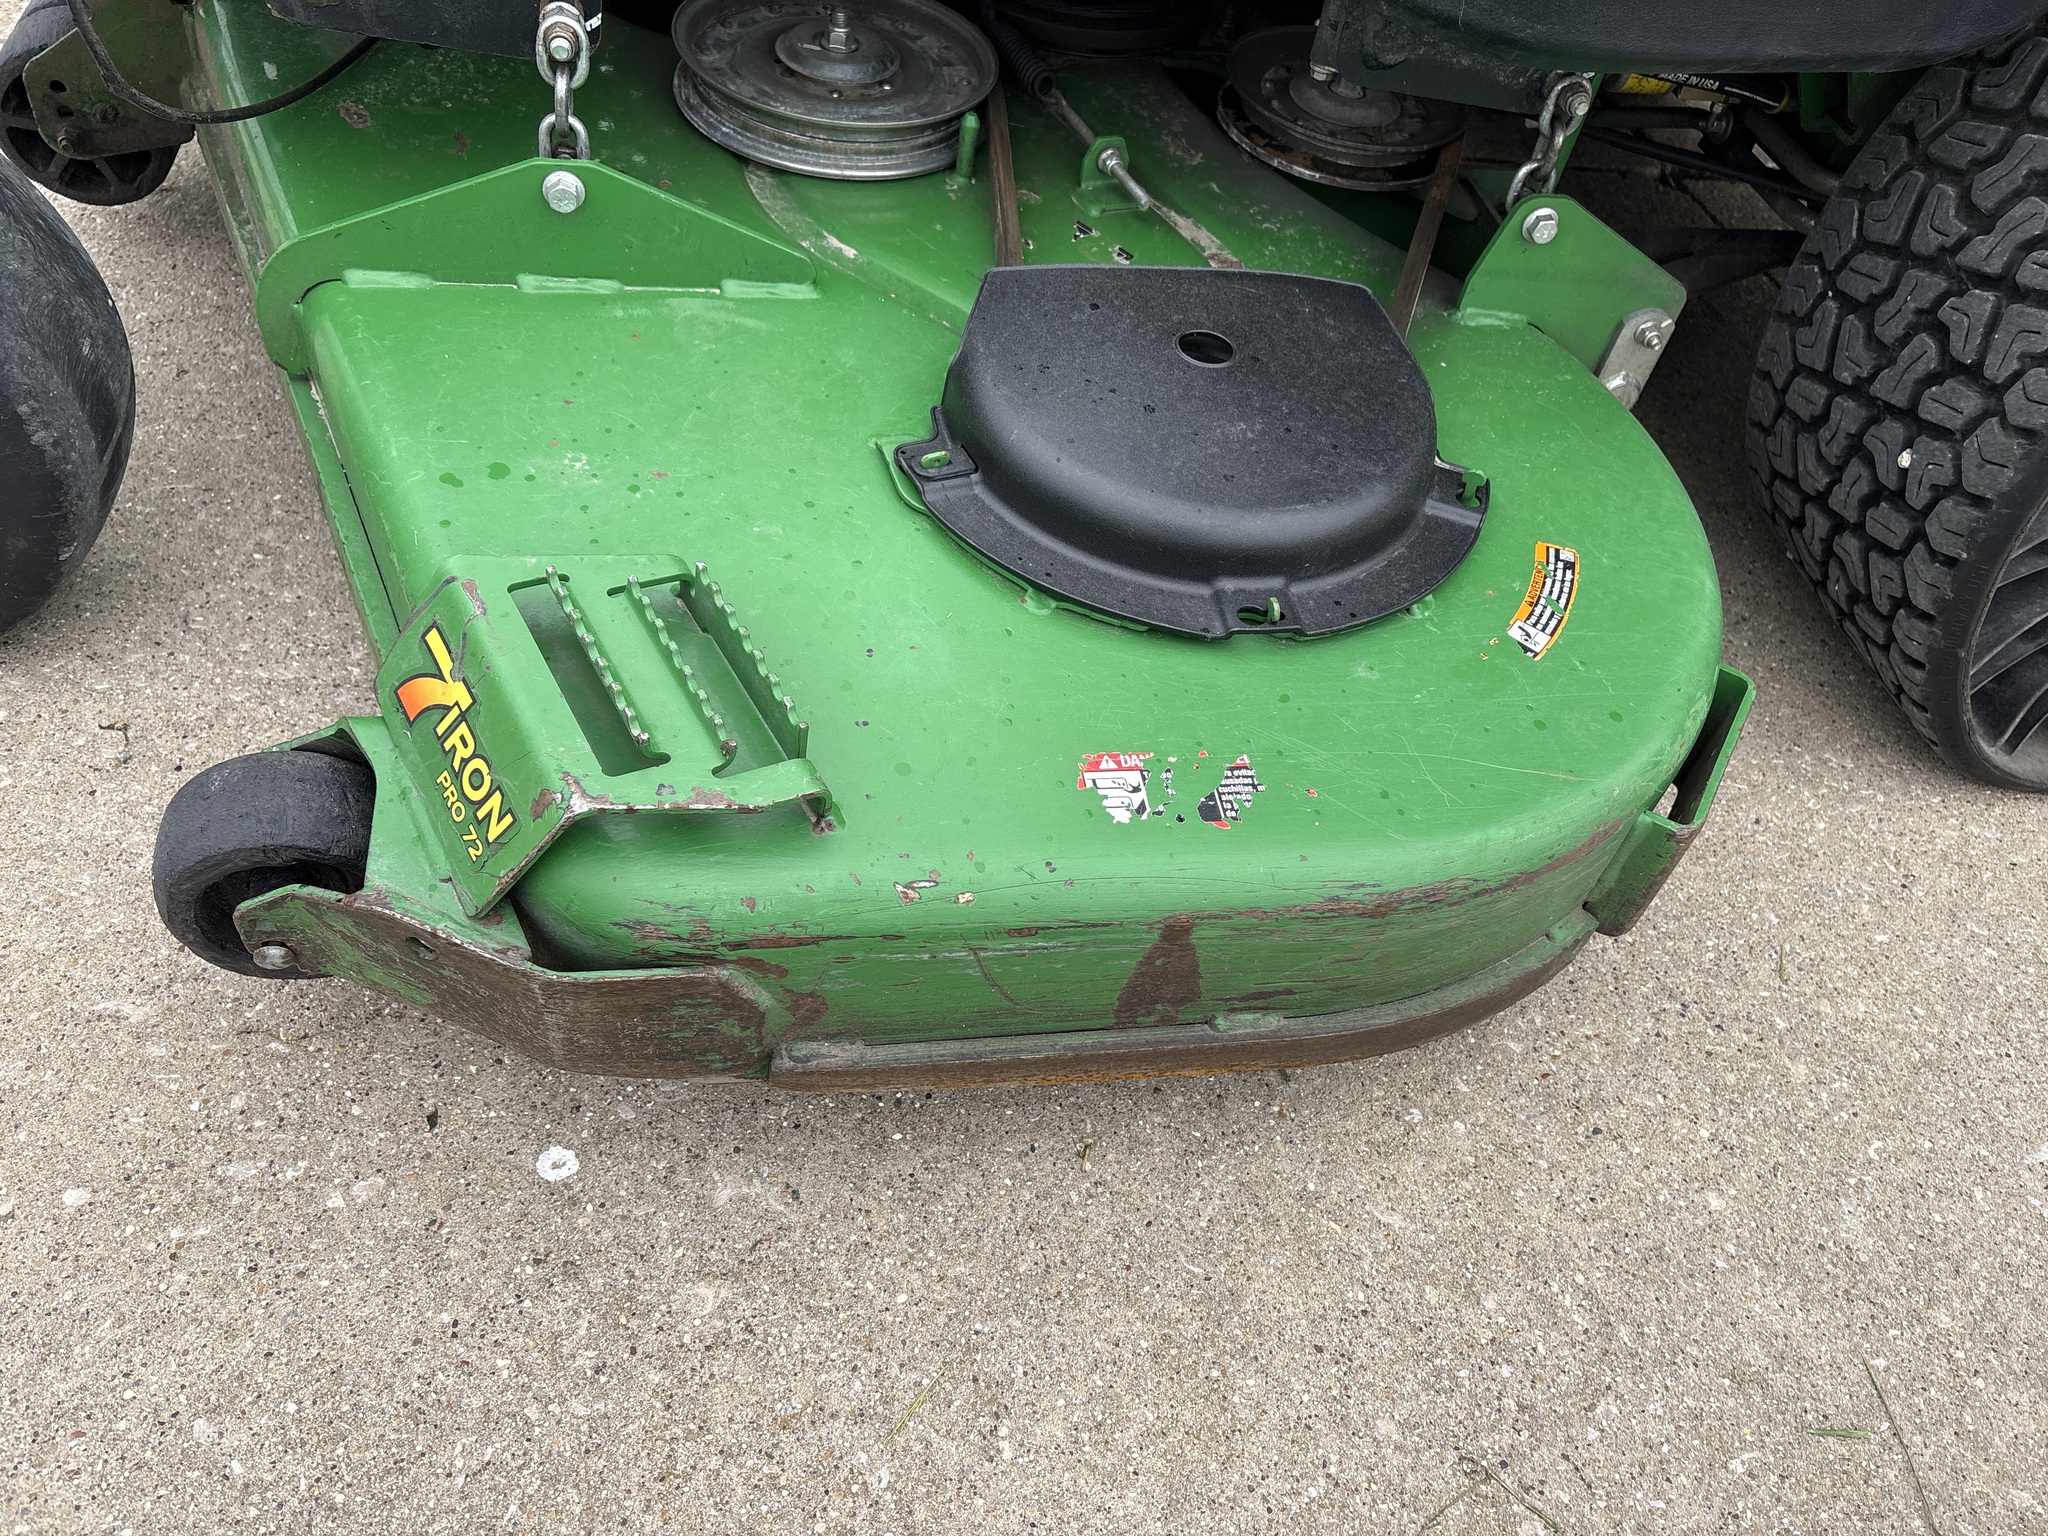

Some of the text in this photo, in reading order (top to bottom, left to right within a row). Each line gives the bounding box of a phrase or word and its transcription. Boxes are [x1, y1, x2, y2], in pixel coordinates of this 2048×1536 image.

[1687, 75, 1699, 86] IN
[1698, 78, 1720, 91] USA
[436, 769, 485, 862] PRO 72
